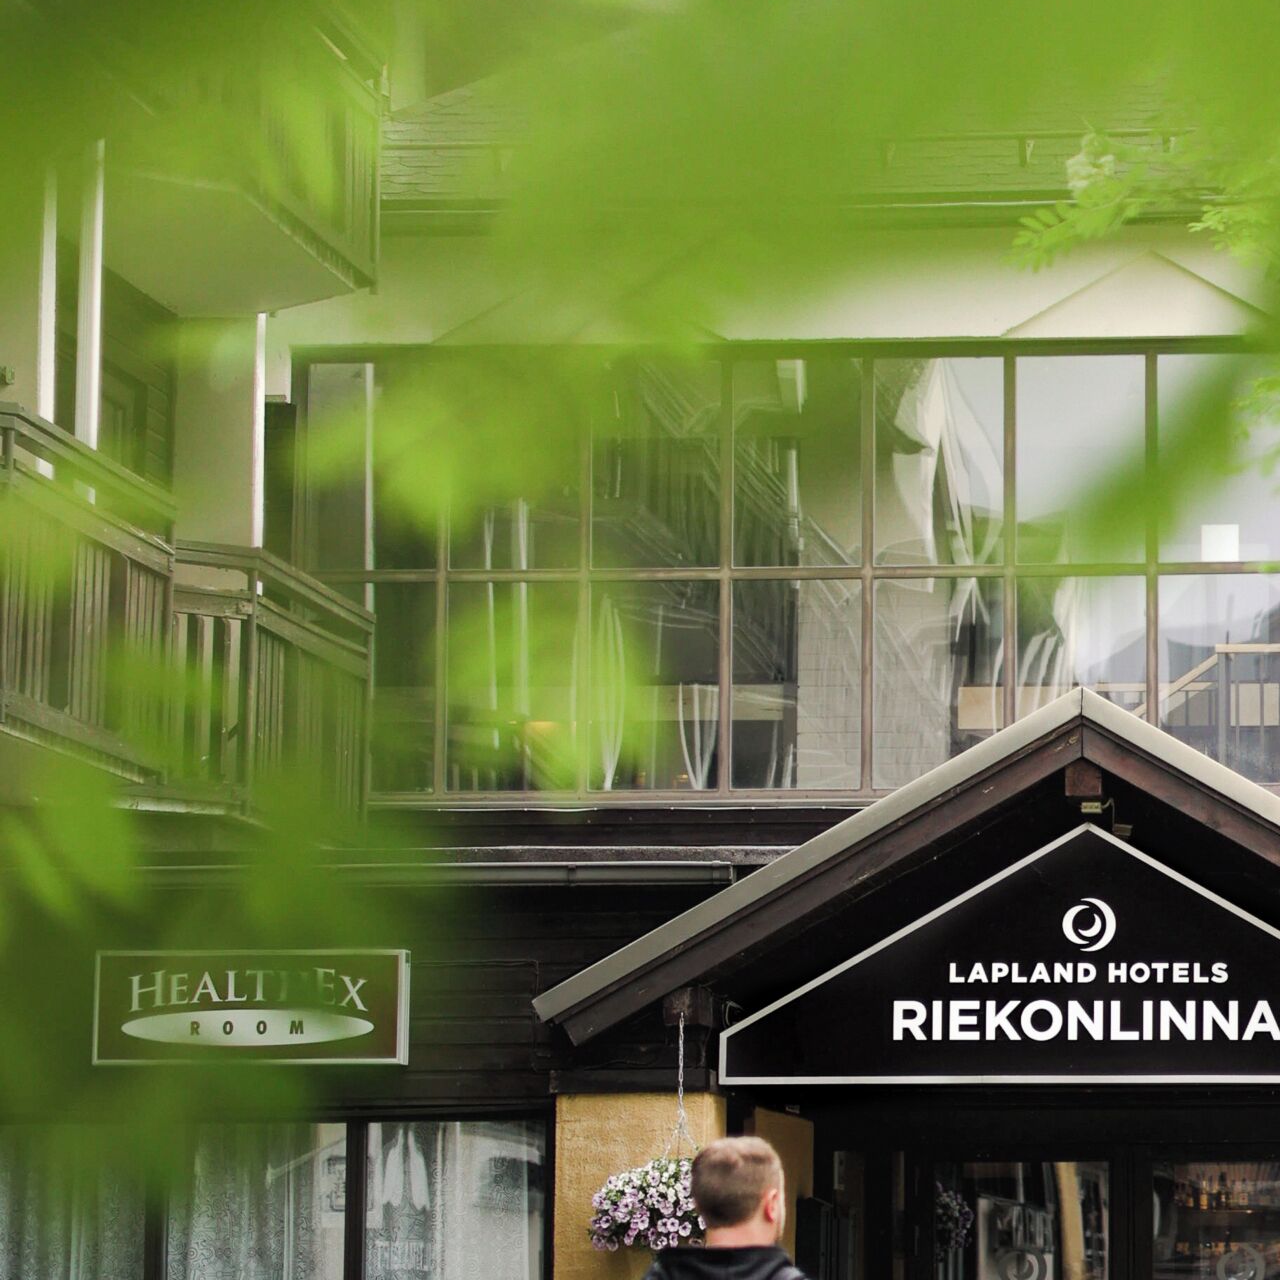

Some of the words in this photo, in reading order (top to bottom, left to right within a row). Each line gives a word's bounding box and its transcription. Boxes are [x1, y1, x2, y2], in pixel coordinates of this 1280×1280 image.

[948, 962, 1097, 984] LAPLAND
[1107, 962, 1229, 984] HOTELS
[189, 1020, 305, 1036] ROOM
